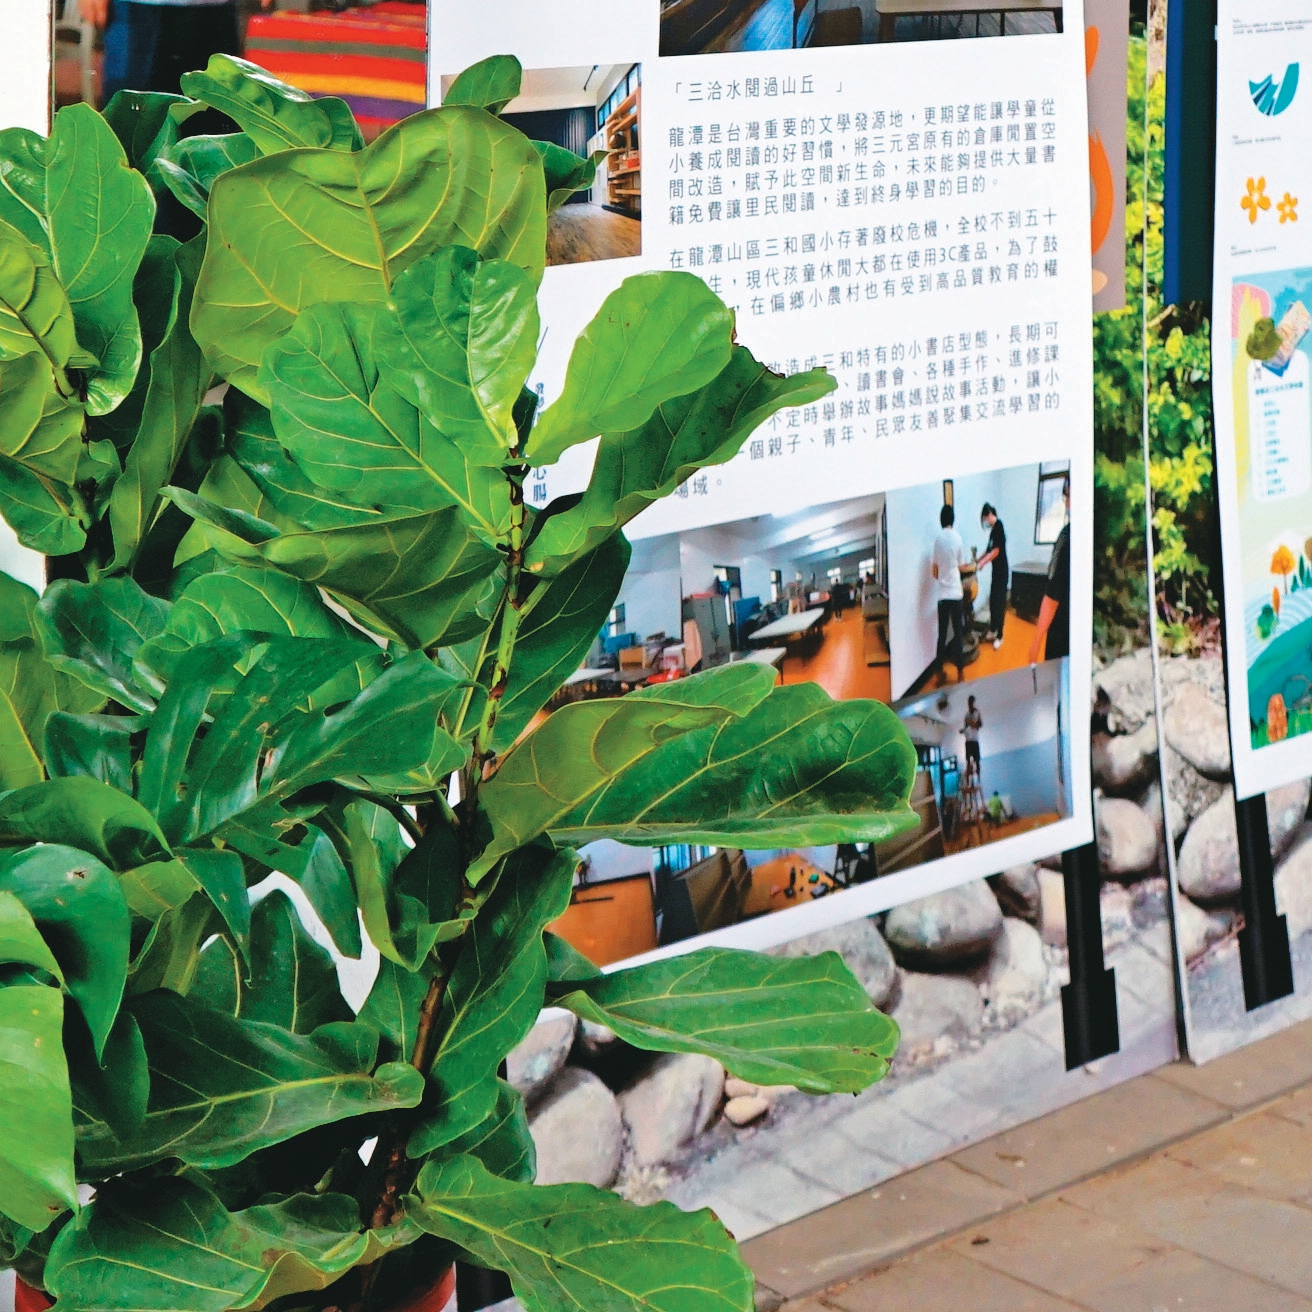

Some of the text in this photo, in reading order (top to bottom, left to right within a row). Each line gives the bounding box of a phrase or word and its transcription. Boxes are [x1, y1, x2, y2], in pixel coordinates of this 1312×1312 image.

[706, 235, 1058, 294] 生，現代孩童休閒大都在使用3C產品，為了鼓
